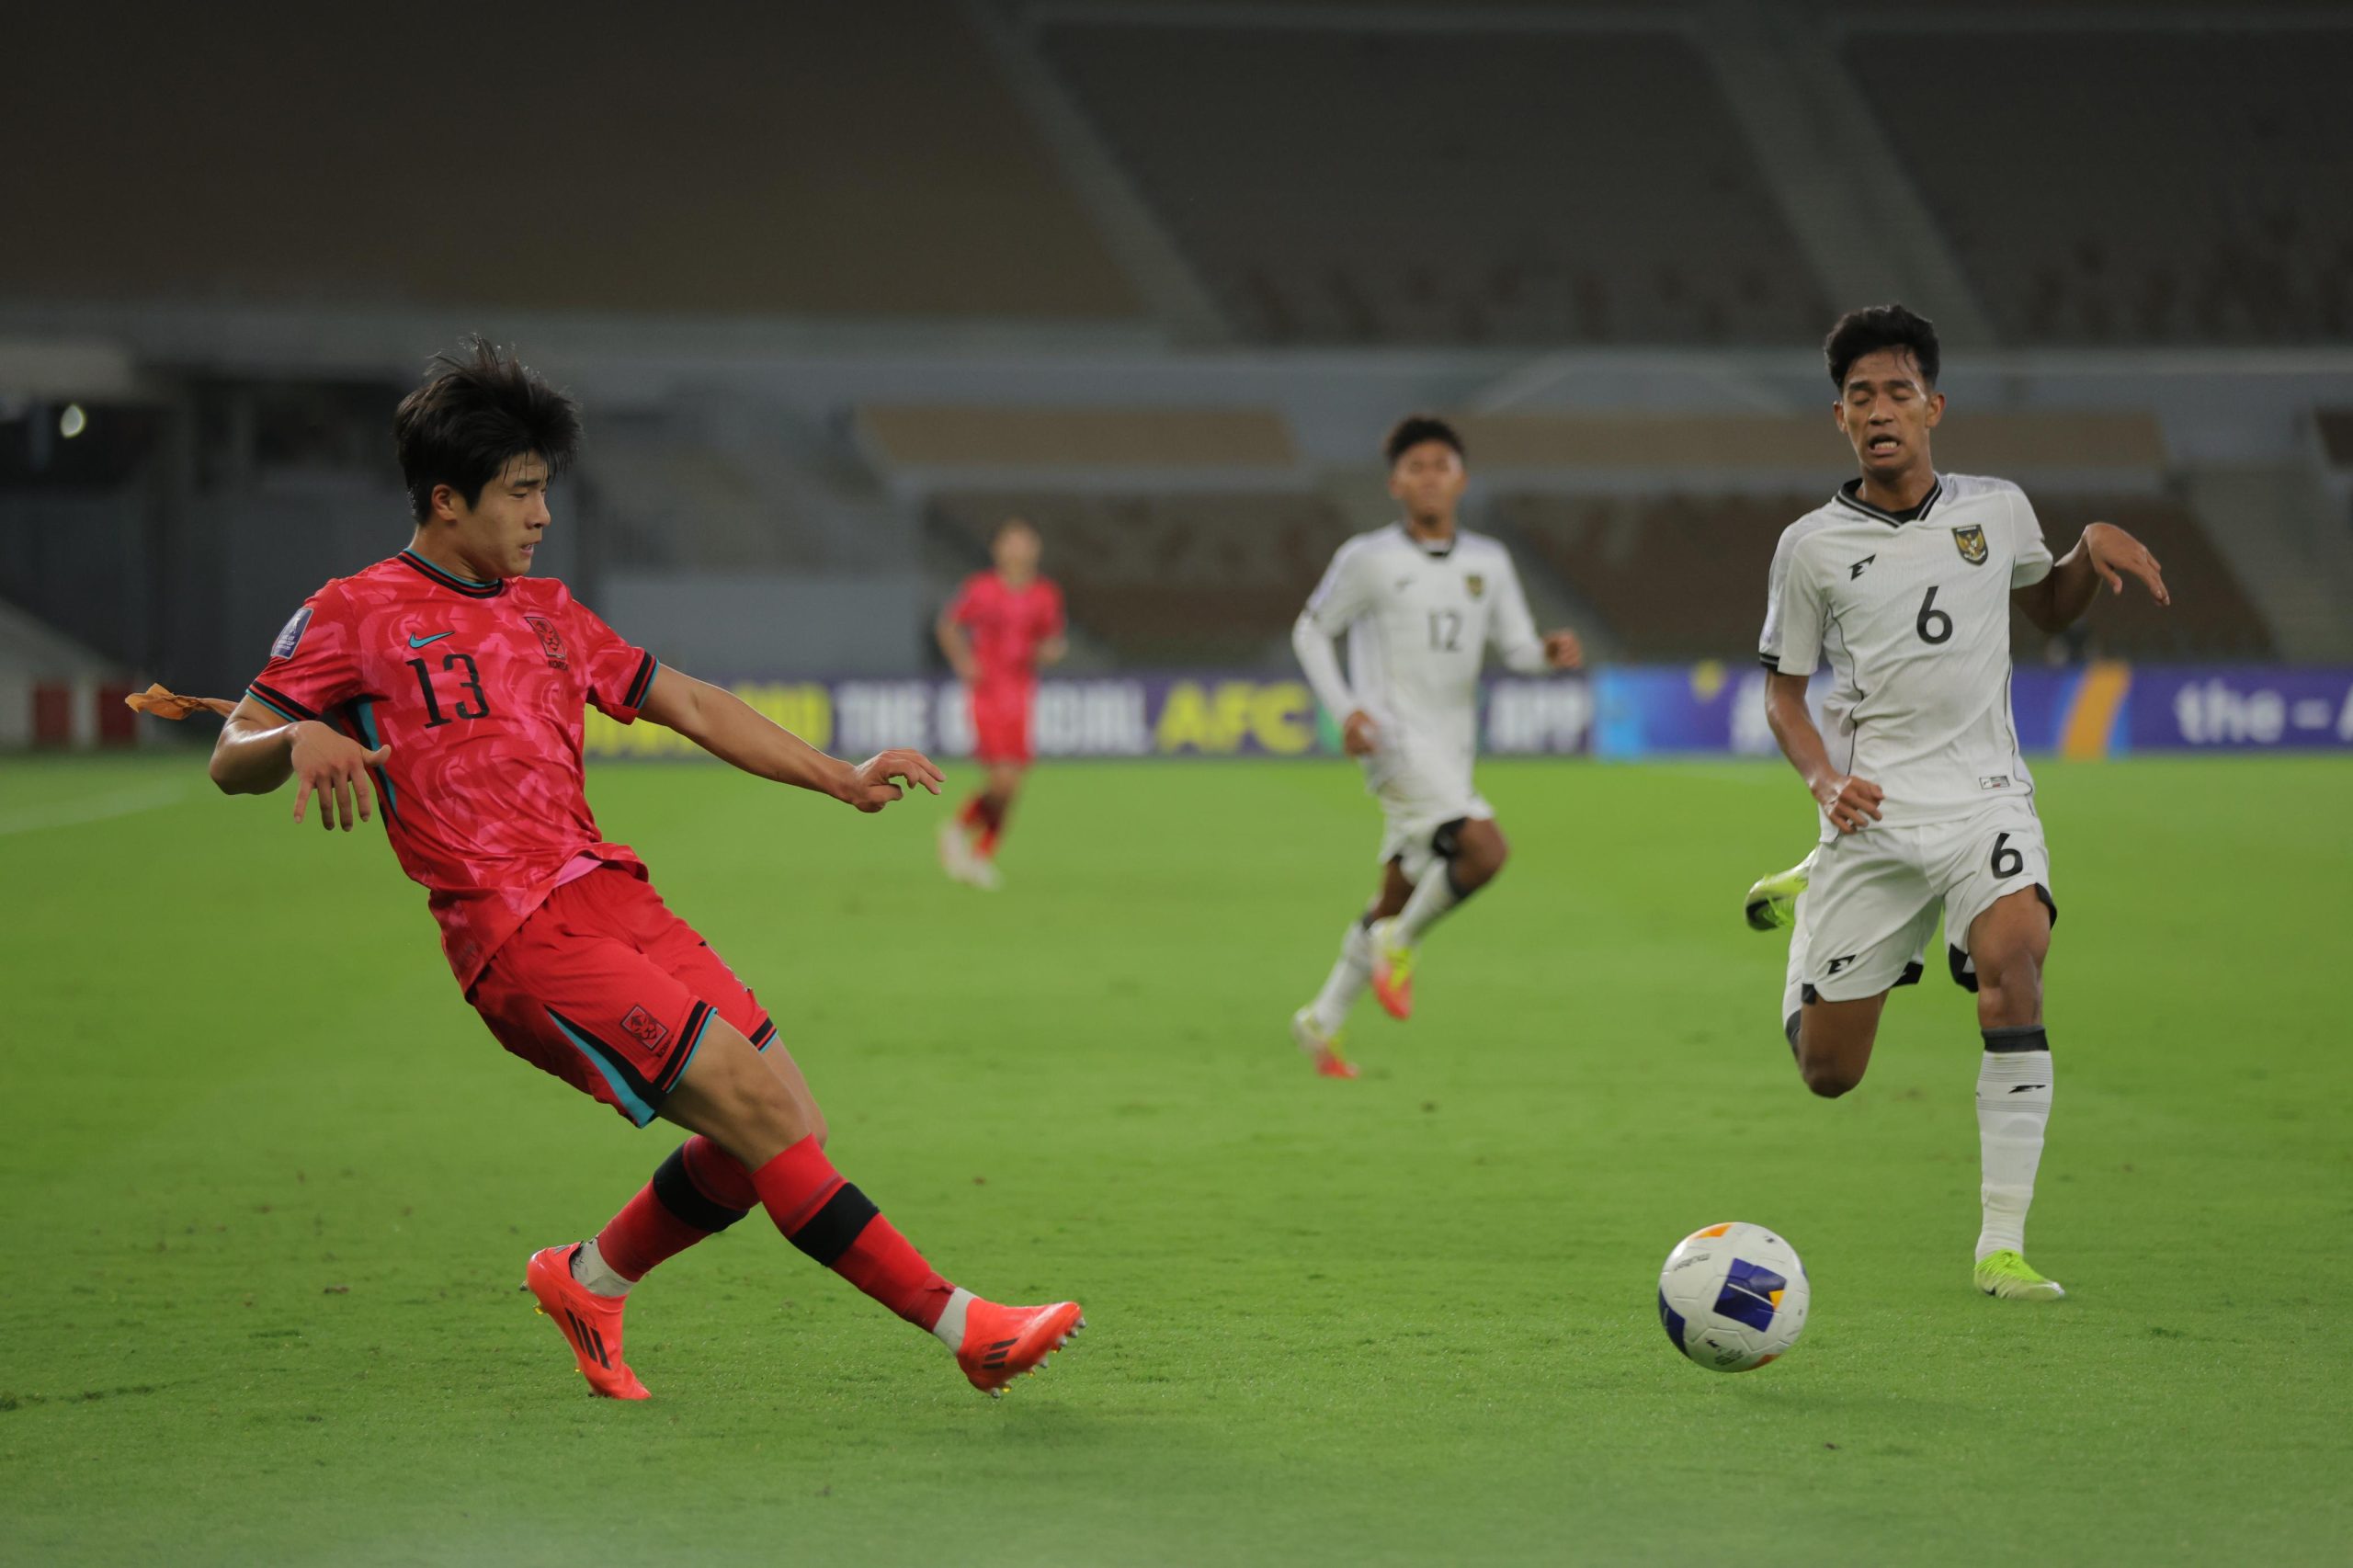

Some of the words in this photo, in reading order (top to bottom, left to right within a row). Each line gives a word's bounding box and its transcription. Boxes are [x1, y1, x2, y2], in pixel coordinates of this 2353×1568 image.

[1428, 609, 1461, 652] 12
[1916, 585, 1953, 644] 6
[405, 653, 490, 729] 13
[1155, 680, 1314, 754] AFC
[1991, 833, 2023, 879] 6
